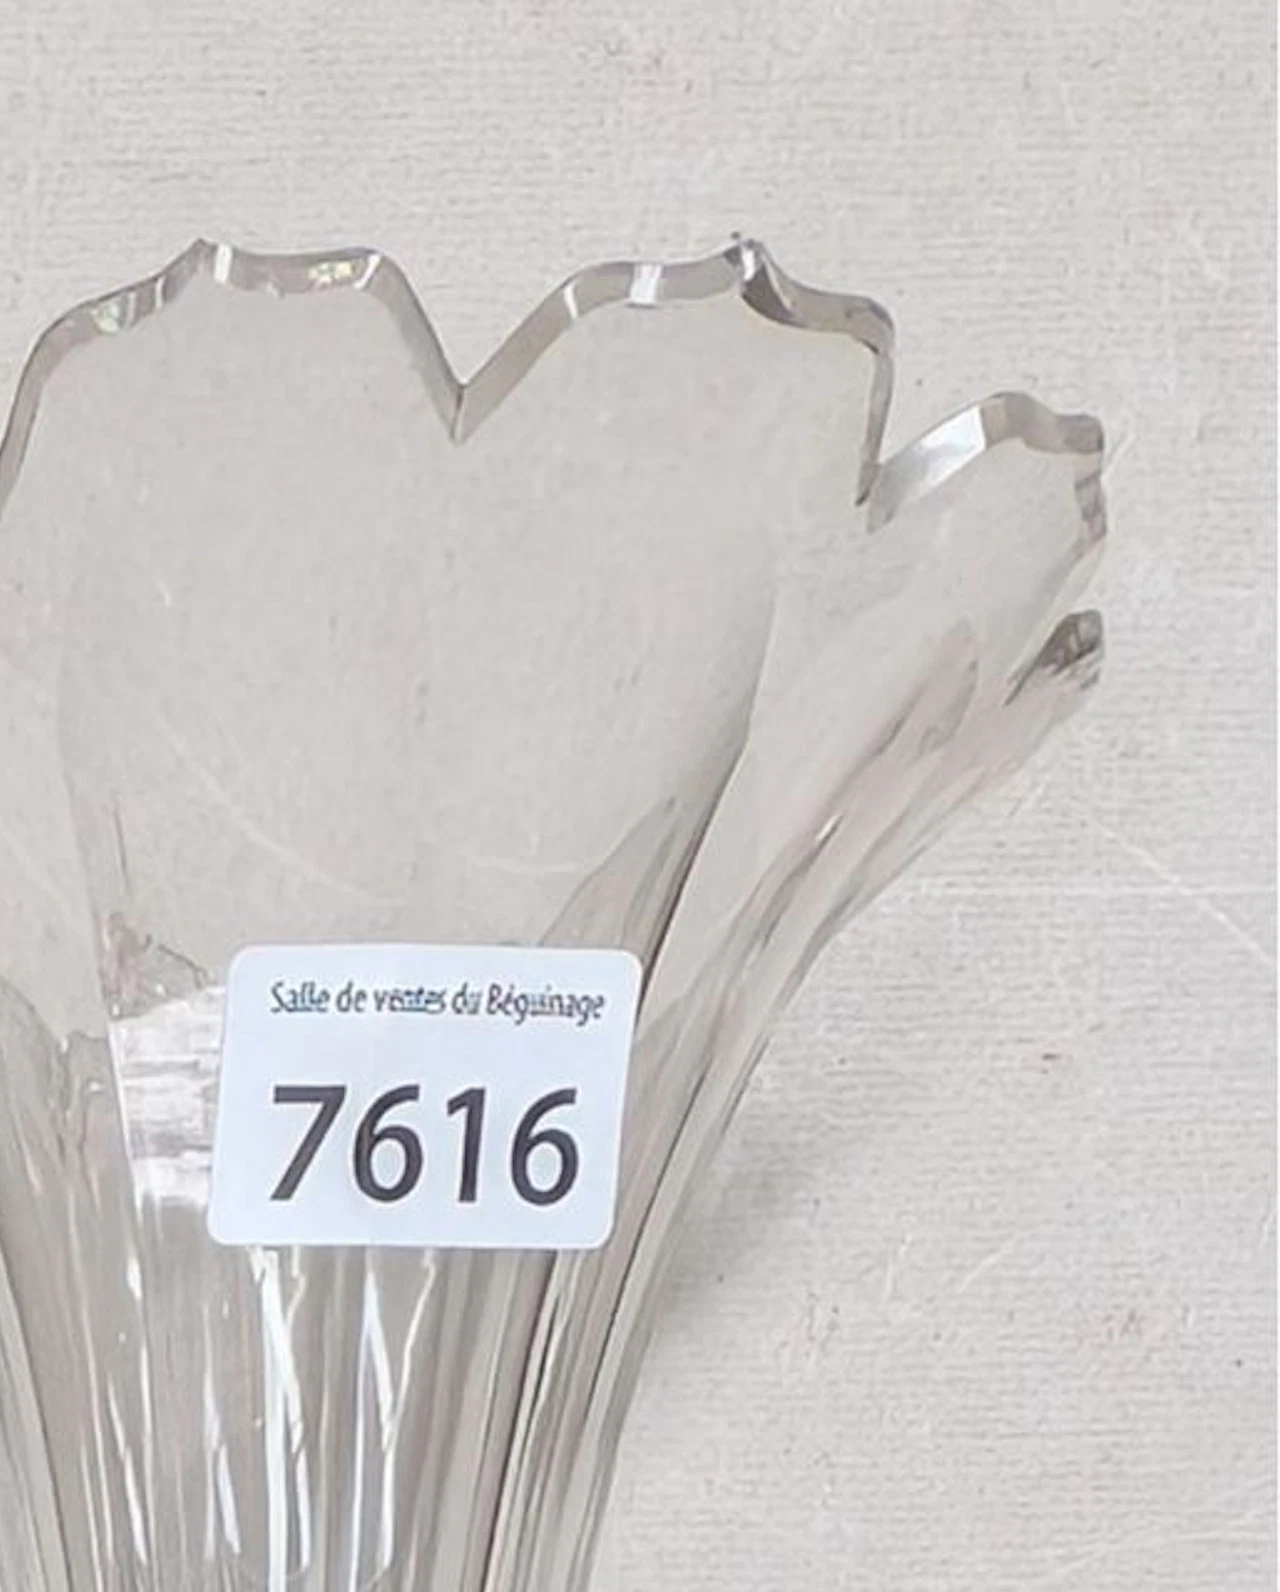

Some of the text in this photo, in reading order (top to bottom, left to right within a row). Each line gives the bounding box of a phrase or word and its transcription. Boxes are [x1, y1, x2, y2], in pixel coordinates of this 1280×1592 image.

[270, 981, 604, 1026] Salle de ventes du Béguinage
[269, 1083, 580, 1207] 7616
